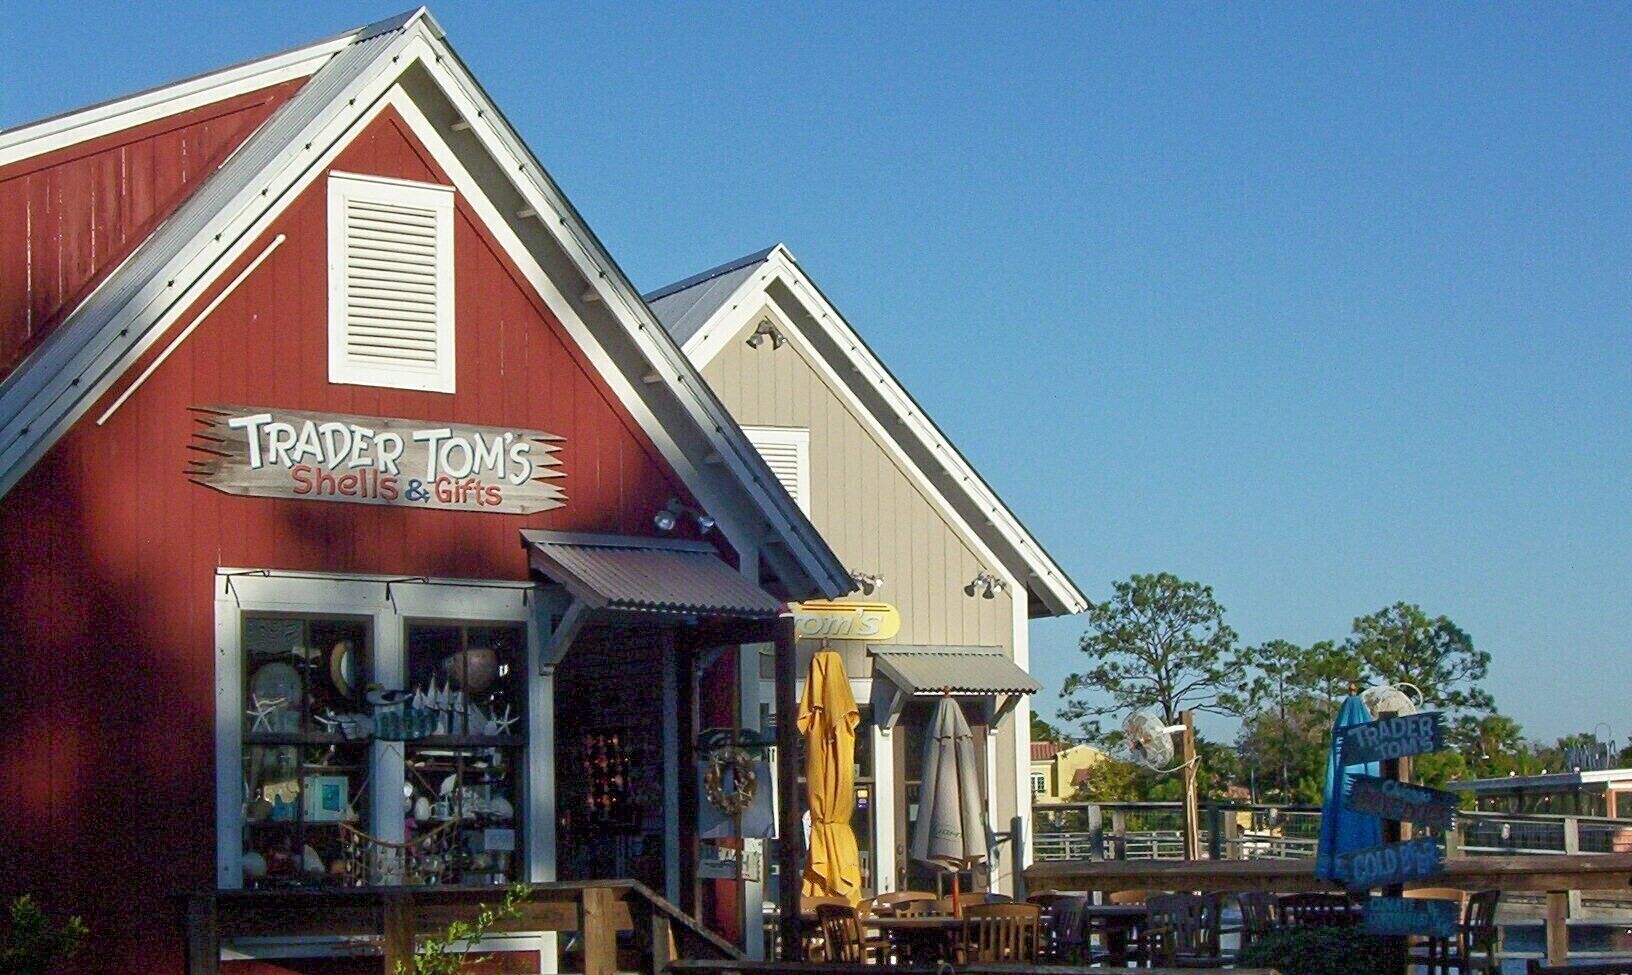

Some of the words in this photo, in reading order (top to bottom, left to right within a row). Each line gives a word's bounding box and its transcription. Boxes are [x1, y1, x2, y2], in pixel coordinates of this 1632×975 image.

[228, 413, 404, 476] TRADER
[413, 428, 533, 485] TOM'S
[291, 464, 399, 500] Shells
[404, 478, 431, 504] &
[434, 476, 503, 507] Gifts
[795, 608, 882, 636] om's
[1347, 716, 1434, 747] TRADER
